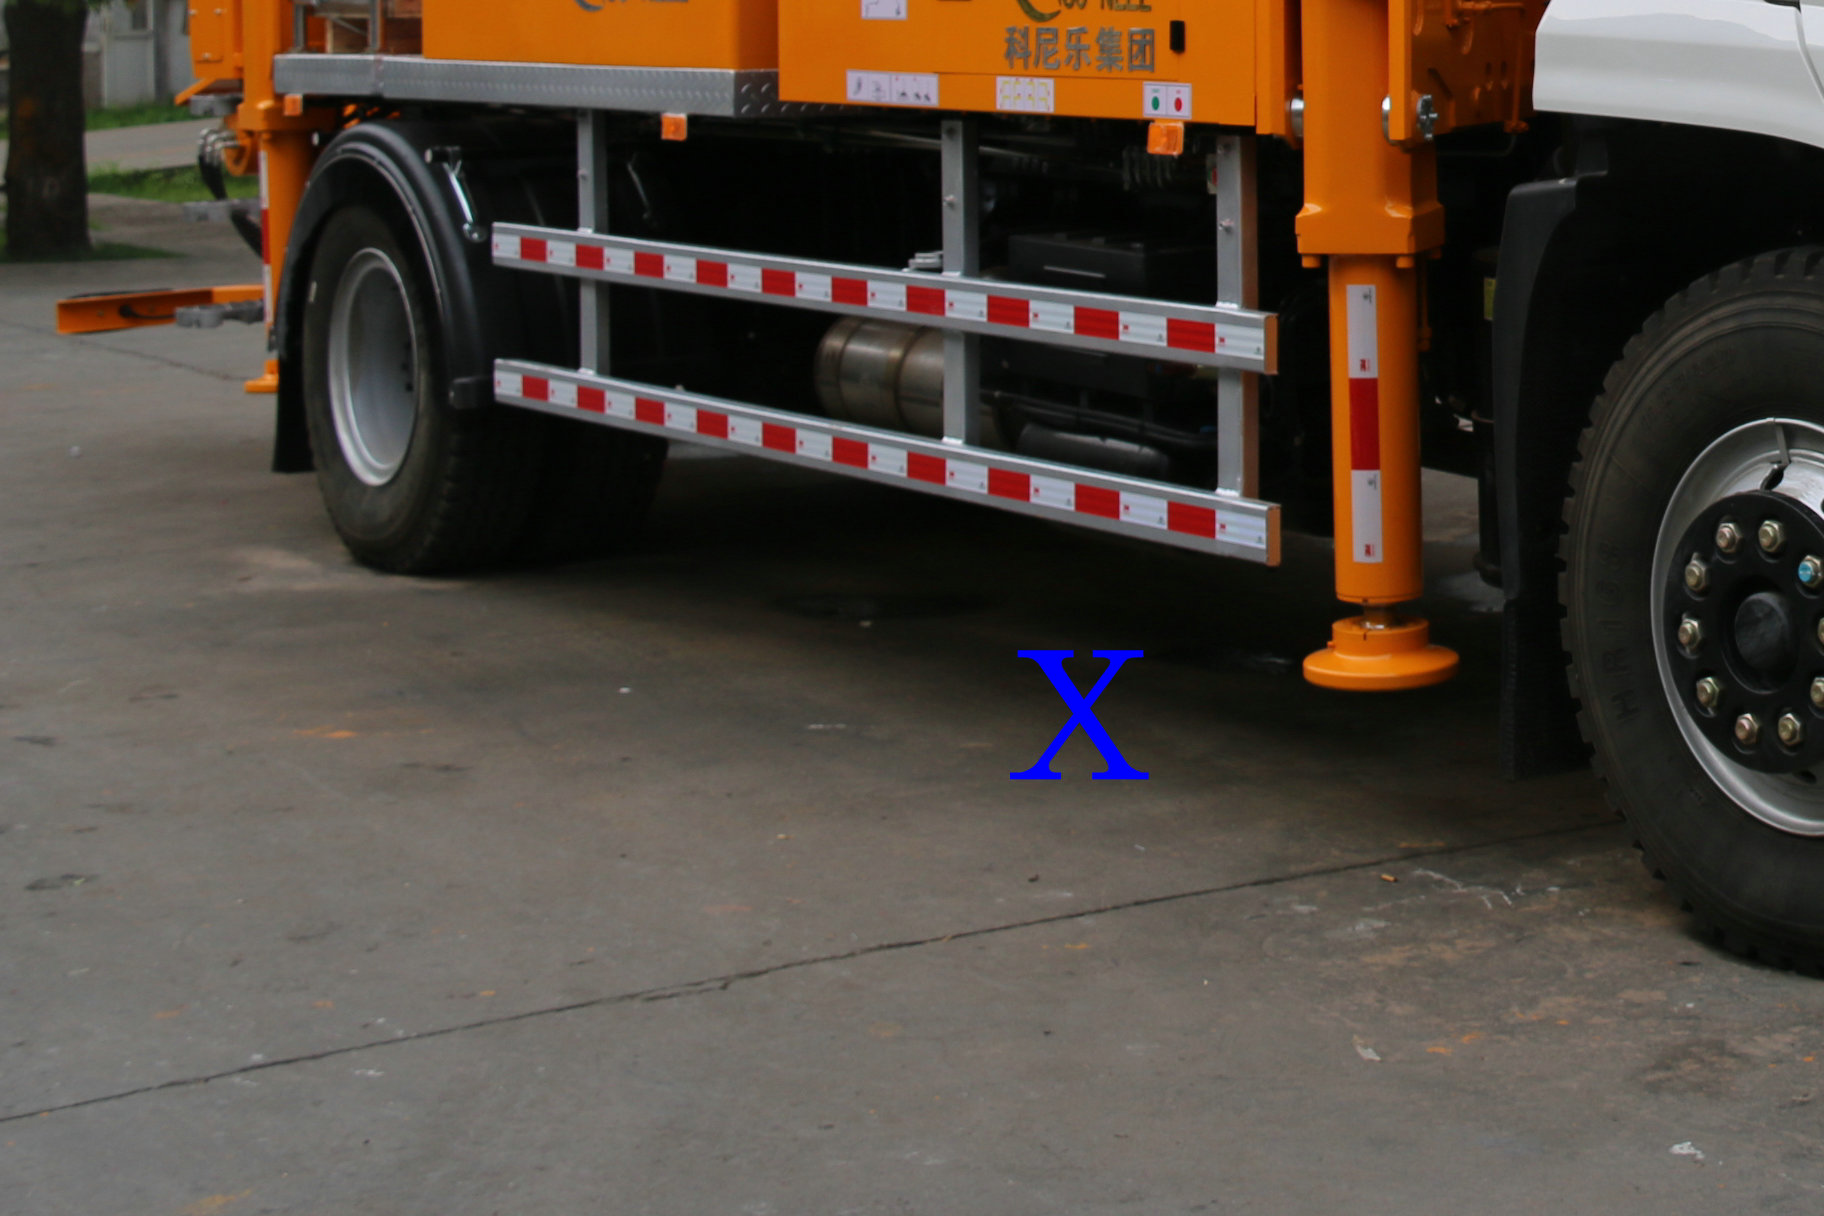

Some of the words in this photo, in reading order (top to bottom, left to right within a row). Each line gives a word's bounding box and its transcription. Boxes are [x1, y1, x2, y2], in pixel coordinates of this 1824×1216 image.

[1004, 24, 1155, 73] 科尼乐集团
